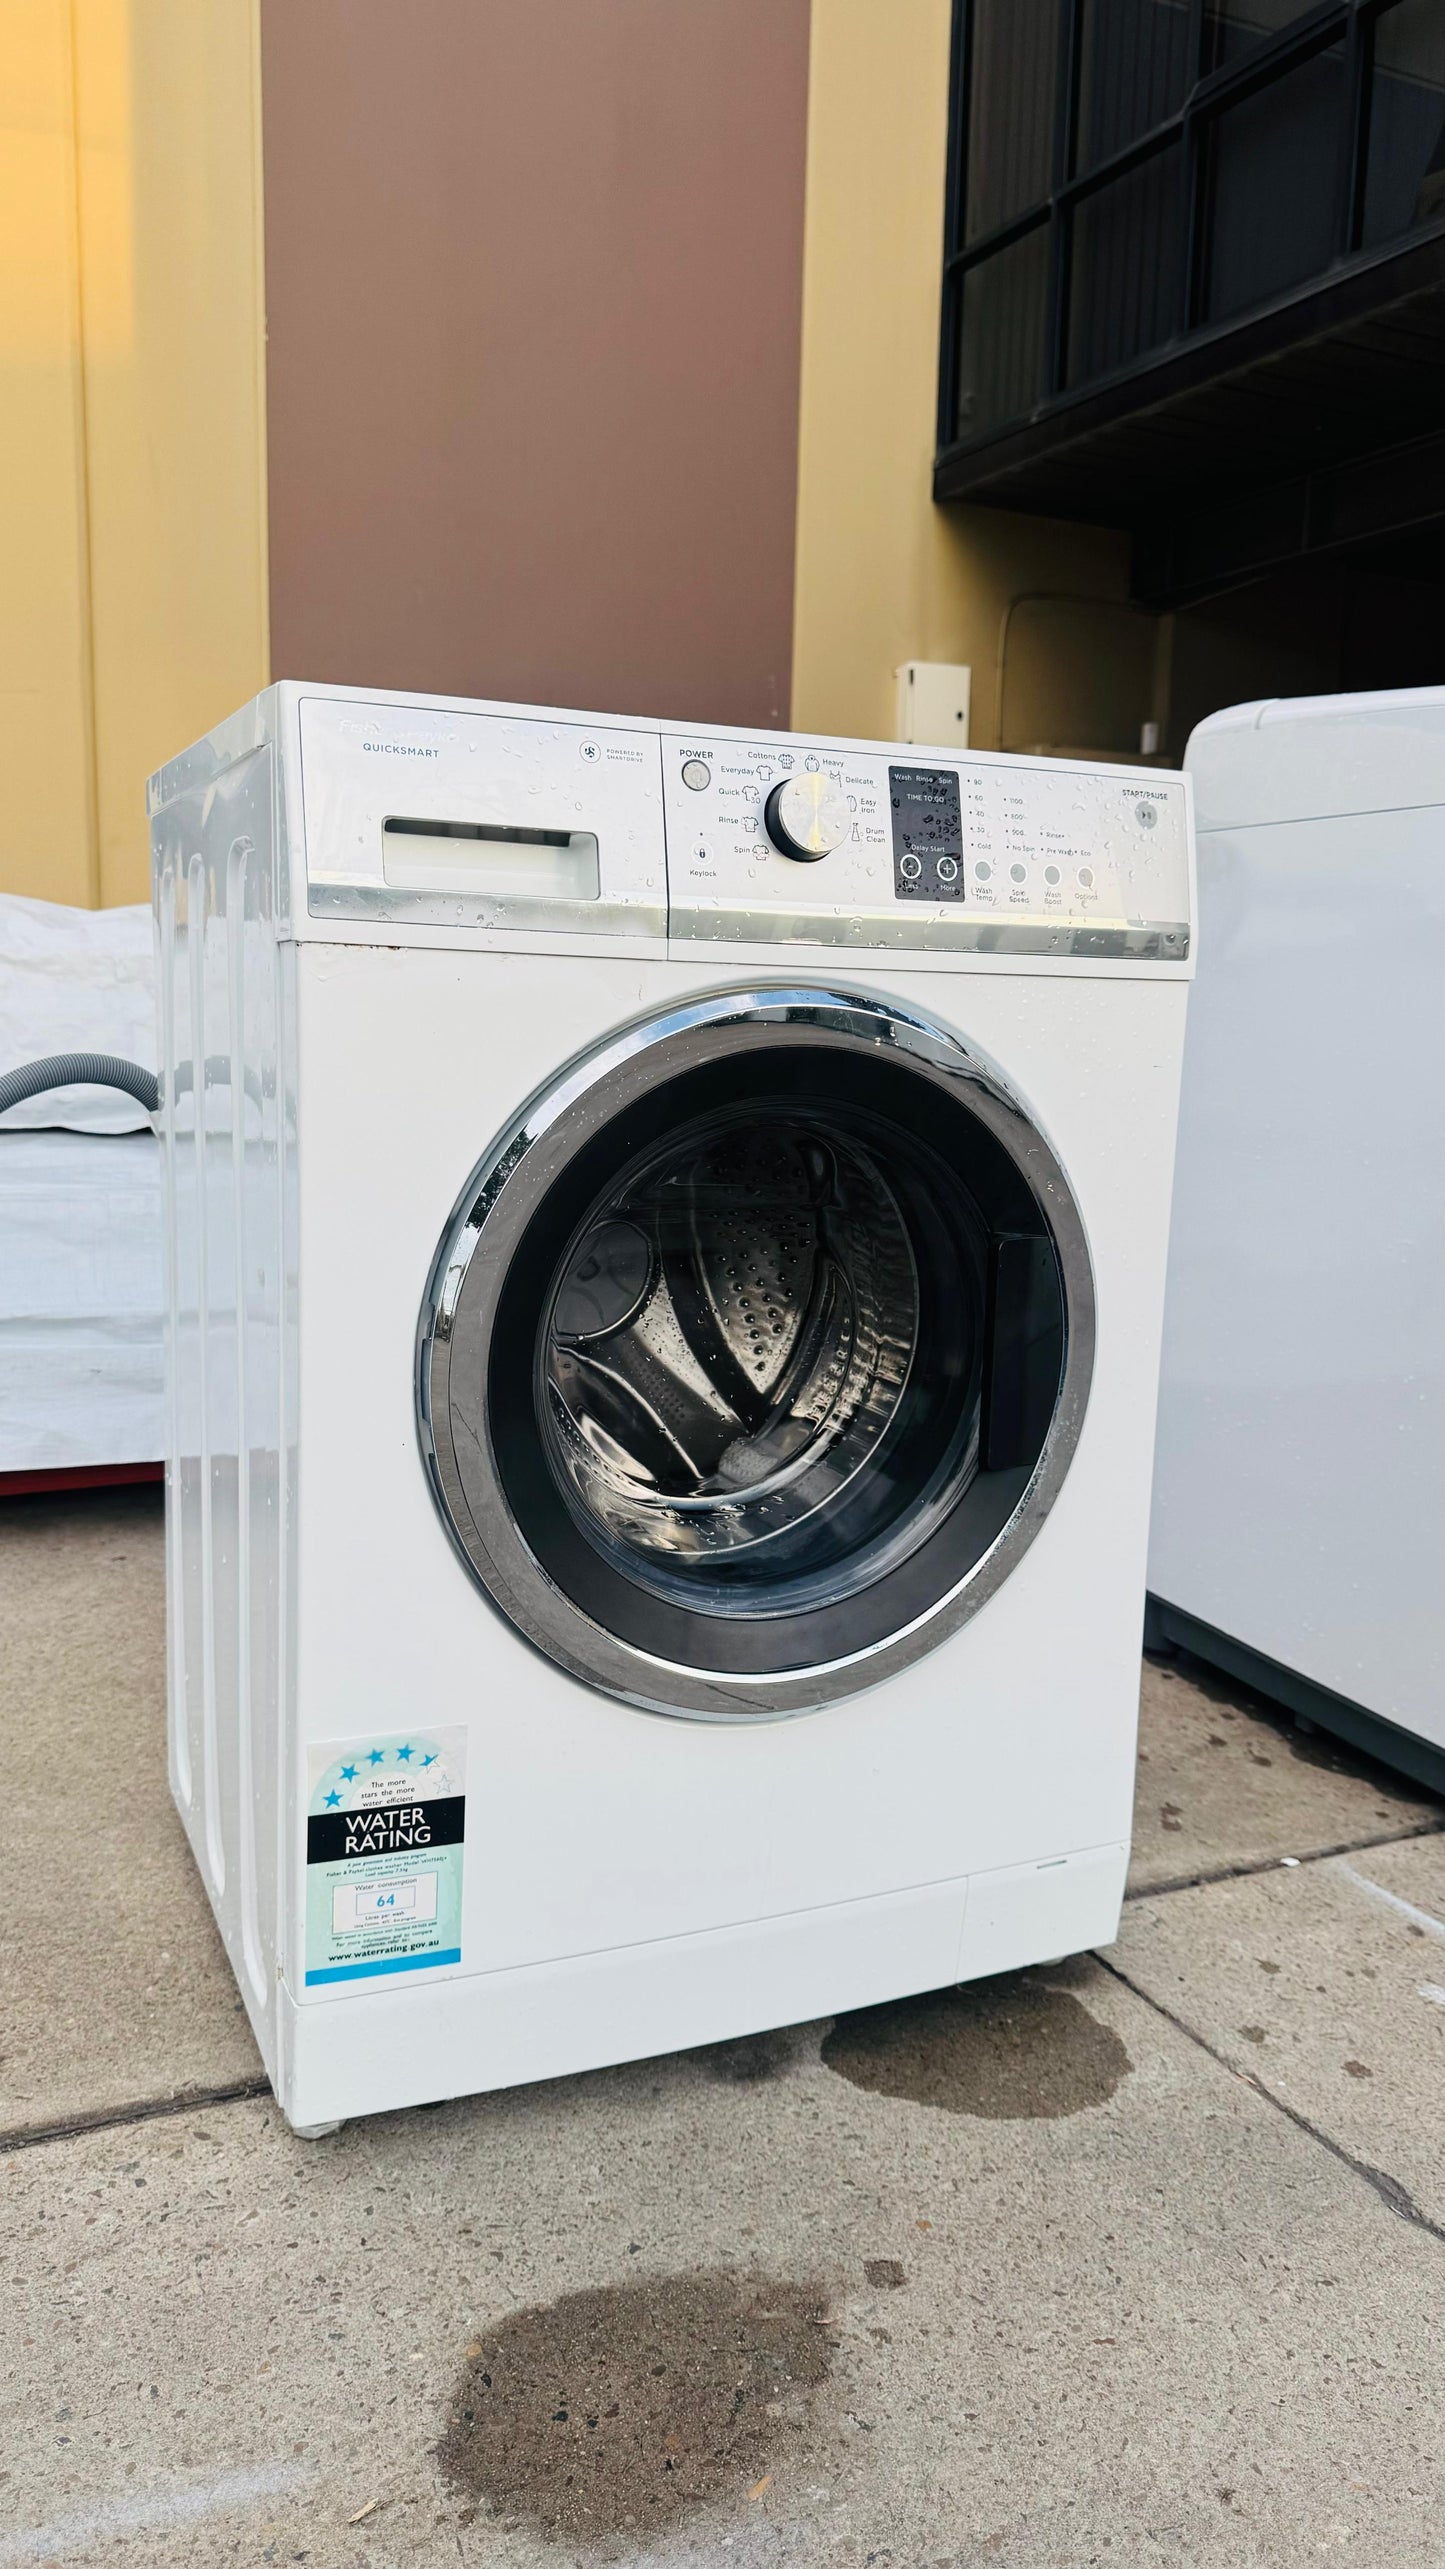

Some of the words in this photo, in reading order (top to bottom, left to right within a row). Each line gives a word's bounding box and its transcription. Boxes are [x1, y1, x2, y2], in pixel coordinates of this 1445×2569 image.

[363, 742, 439, 758] QUICKSMART
[679, 749, 714, 759] POWER
[747, 751, 777, 760] Cottons
[822, 758, 844, 768] Heavy
[720, 765, 755, 776] Everyday
[845, 776, 874, 785] Delicate
[894, 773, 912, 781] Wash
[938, 777, 953, 785] Spin
[718, 787, 740, 796] Quick
[1122, 789, 1168, 800] START/PAUSE
[750, 796, 761, 804] 30
[906, 793, 923, 801] TIME
[860, 798, 877, 807] Easy
[718, 816, 739, 825] Rinse
[865, 827, 885, 835] Drum
[866, 835, 886, 843] Clean
[733, 845, 751, 854] Spin
[911, 843, 929, 852] Delay
[977, 842, 992, 850] Cold
[1022, 845, 1035, 853] Spin
[689, 869, 717, 877] Keylock
[976, 894, 993, 902] Temp
[1044, 897, 1062, 905] Boost
[361, 1791, 378, 1799] stars
[396, 1786, 415, 1794] more
[362, 1799, 383, 1807] water
[386, 1795, 414, 1804] efficient
[345, 1807, 426, 1834] WATER
[344, 1825, 431, 1854] RATING
[377, 1878, 418, 1888] consumption
[376, 1893, 395, 1907] 64
[328, 1939, 440, 1962] www.waterrating.gov.au
